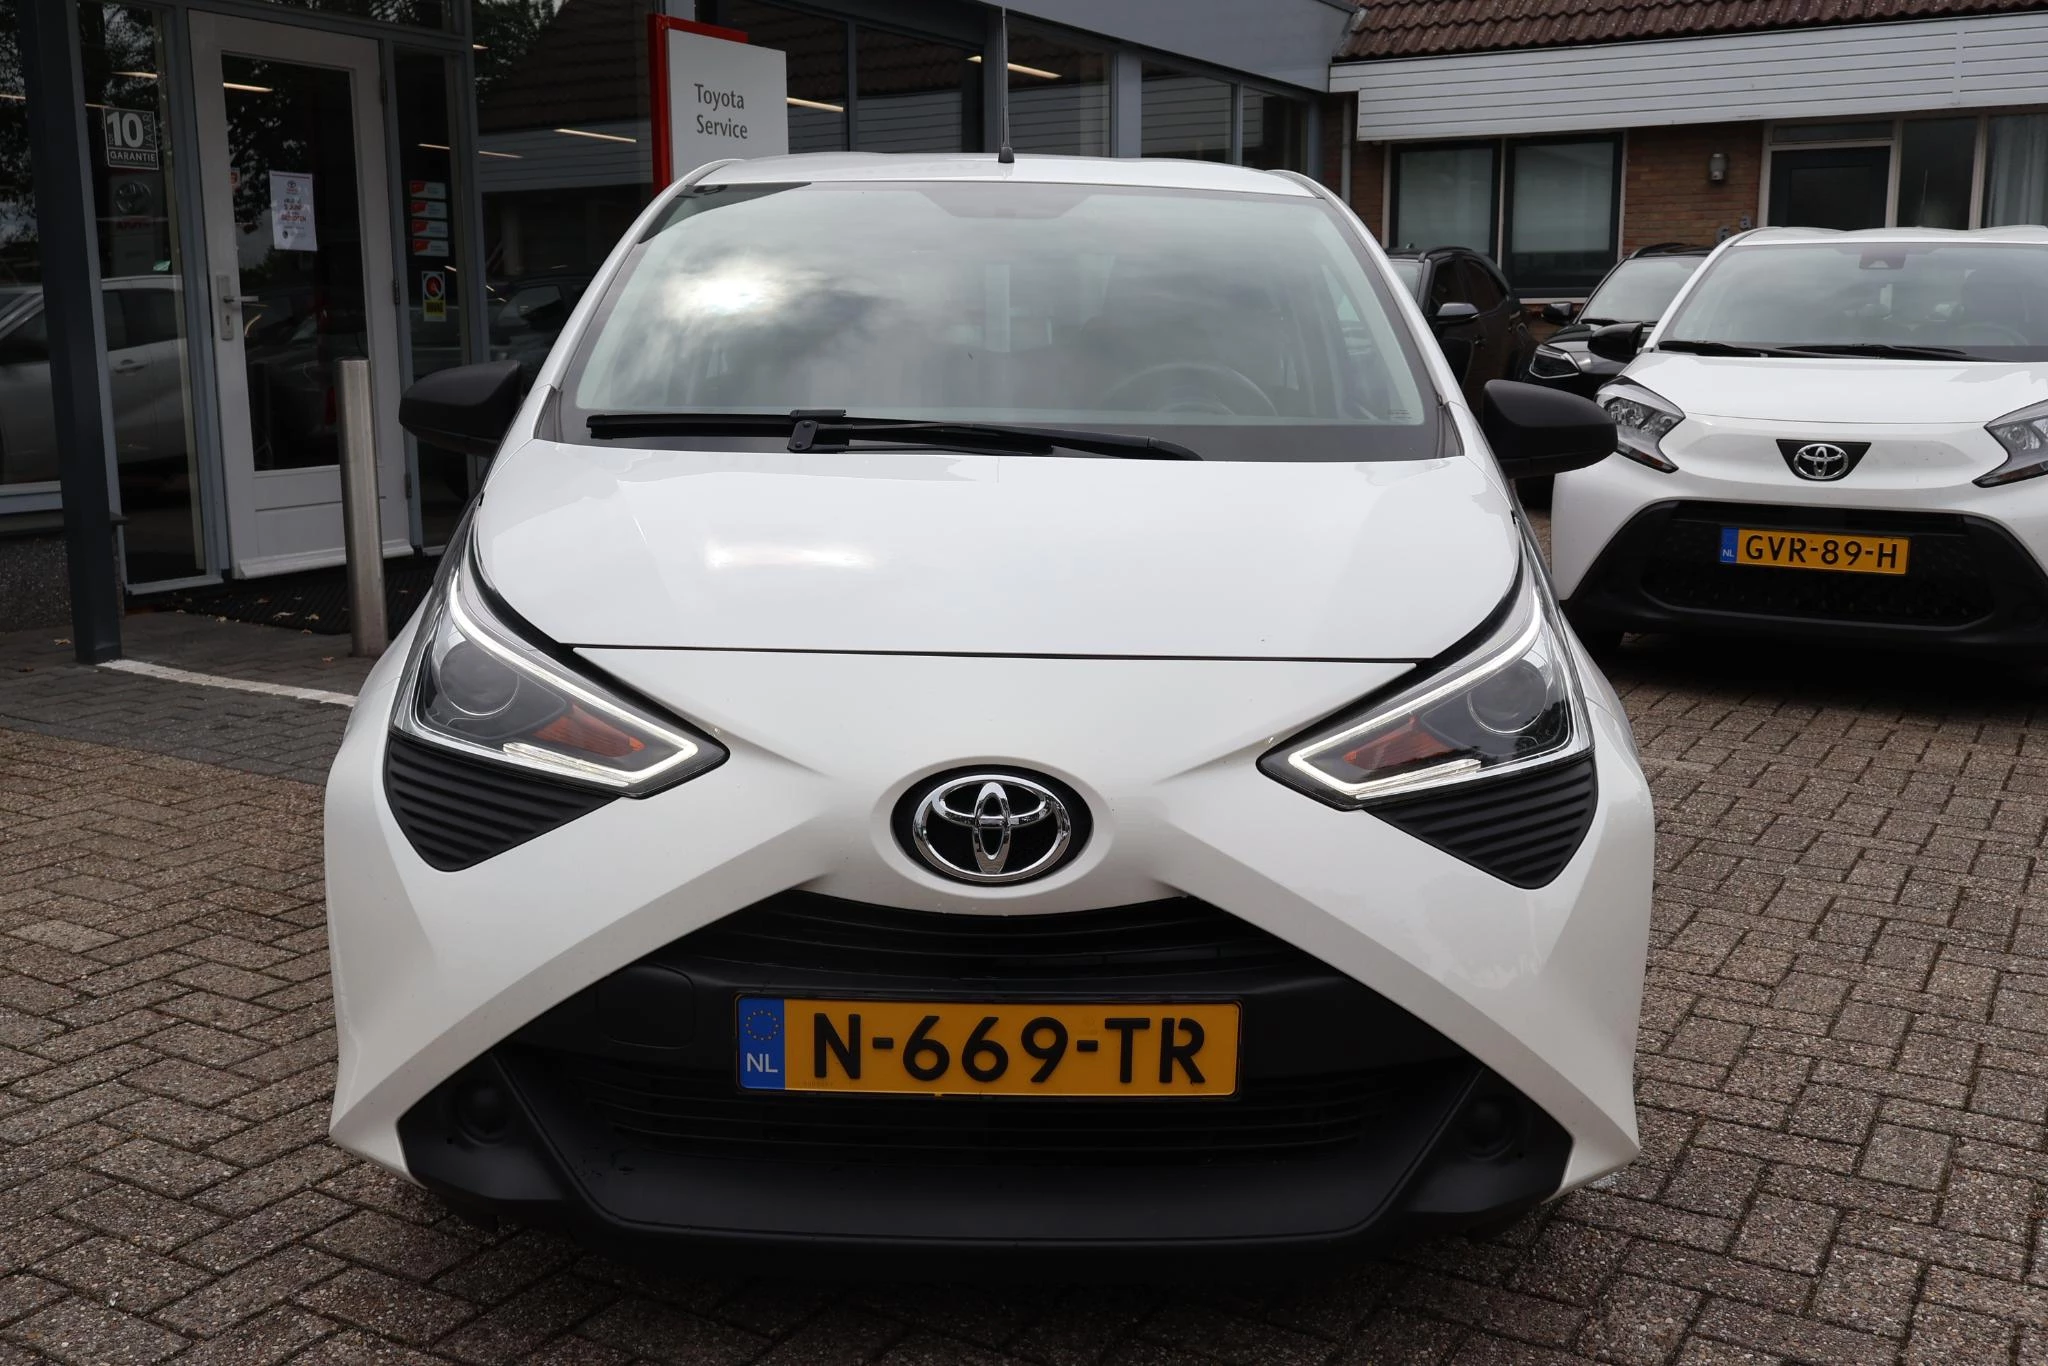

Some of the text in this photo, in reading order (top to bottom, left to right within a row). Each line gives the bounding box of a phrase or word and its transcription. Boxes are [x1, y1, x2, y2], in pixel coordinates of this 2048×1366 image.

[694, 83, 745, 111] Toyota
[107, 111, 155, 149] 10 JAAR
[696, 114, 748, 139] Service
[110, 151, 156, 162] GARANTIE
[1722, 534, 1898, 569] NL GVR-89-H
[745, 1012, 1206, 1084] NL N-669-TR
